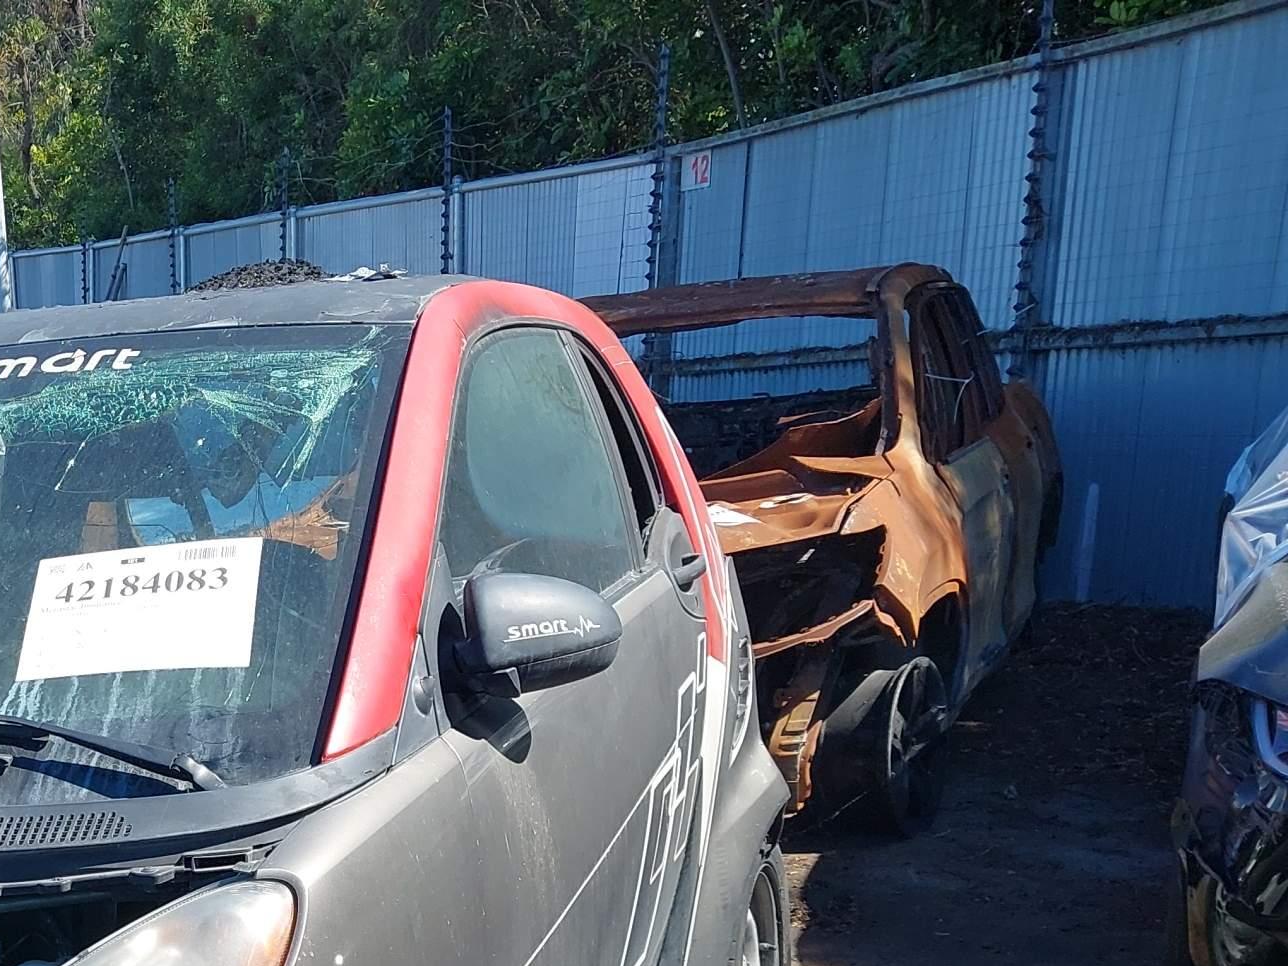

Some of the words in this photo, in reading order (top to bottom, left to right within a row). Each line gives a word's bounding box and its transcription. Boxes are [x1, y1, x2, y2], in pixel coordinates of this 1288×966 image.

[691, 155, 709, 185] 12
[55, 567, 228, 603] 42184083
[508, 620, 568, 638] smart
